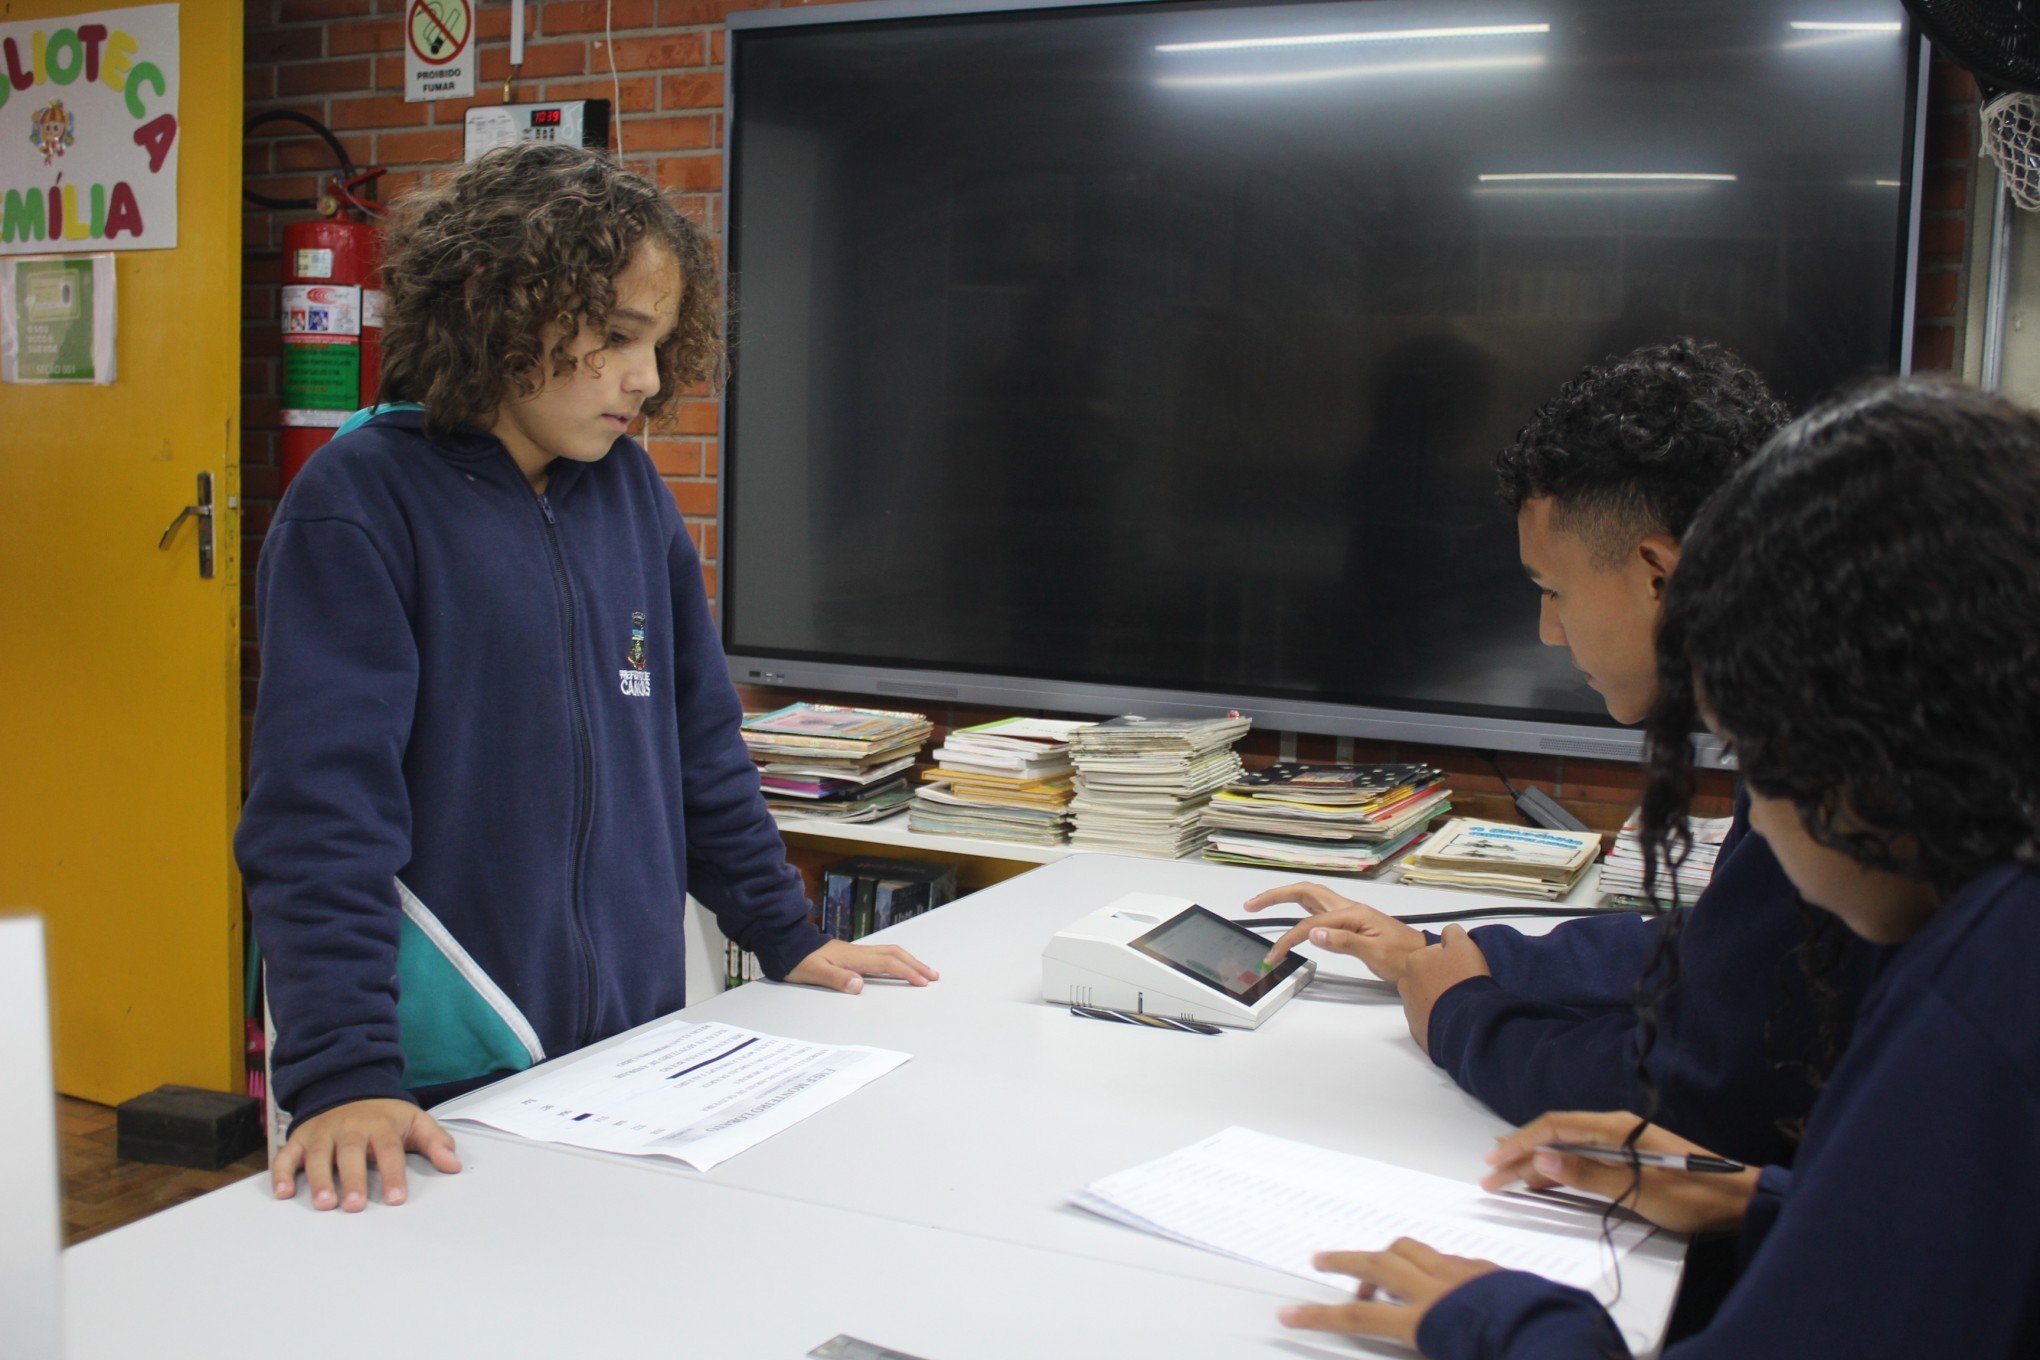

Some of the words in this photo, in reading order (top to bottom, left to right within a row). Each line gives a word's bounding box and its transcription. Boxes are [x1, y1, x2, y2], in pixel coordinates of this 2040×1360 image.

[416, 68, 461, 80] PROIBIDO
[422, 81, 456, 92] FUMAR
[0, 171, 143, 243] MÍLIA
